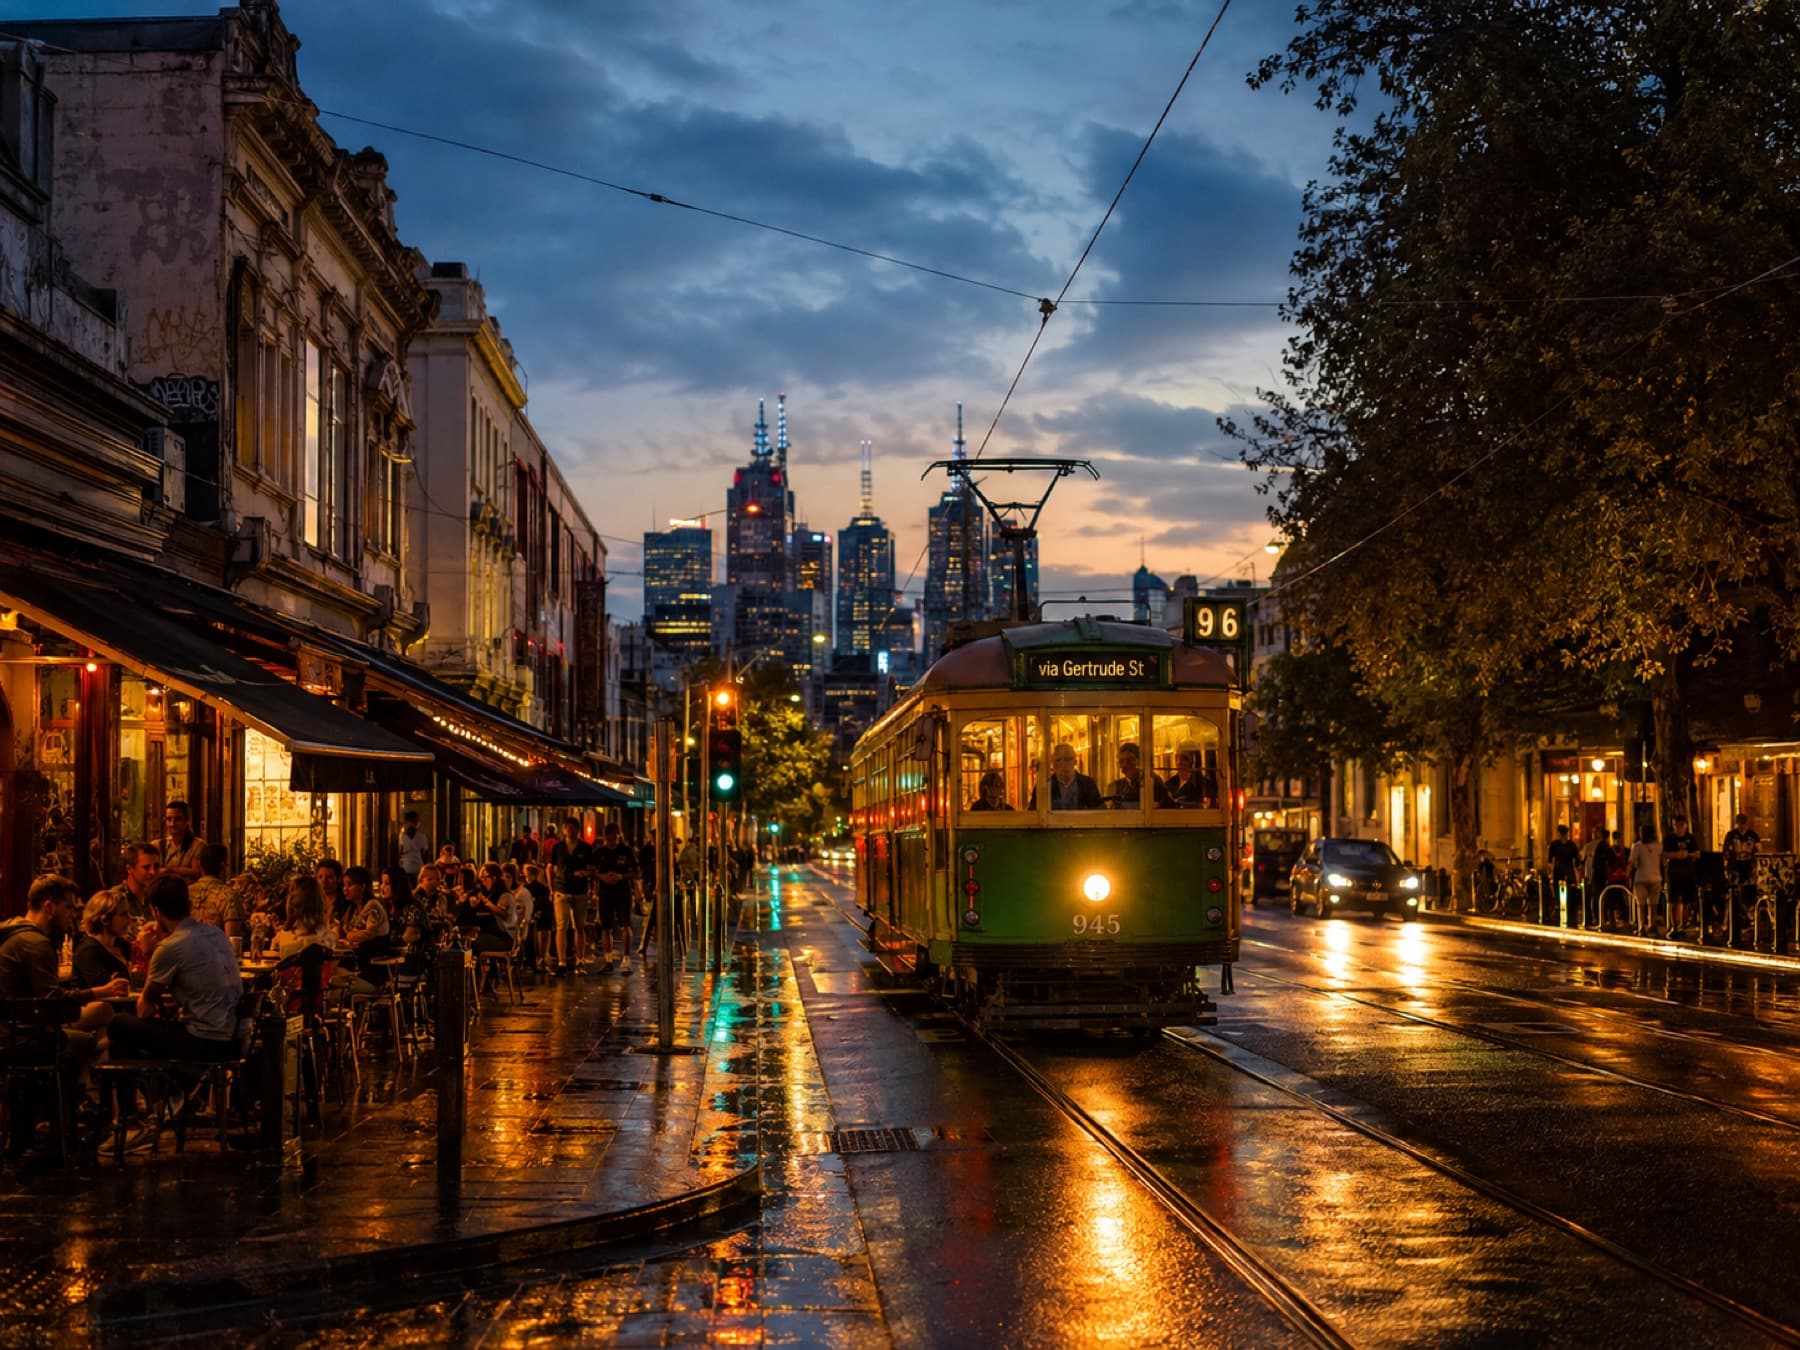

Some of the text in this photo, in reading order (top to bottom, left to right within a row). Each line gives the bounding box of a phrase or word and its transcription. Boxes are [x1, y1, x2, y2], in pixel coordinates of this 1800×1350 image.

[1197, 607, 1238, 637] 96
[1038, 659, 1145, 677] via Gertrude St
[1072, 913, 1121, 935] 945
